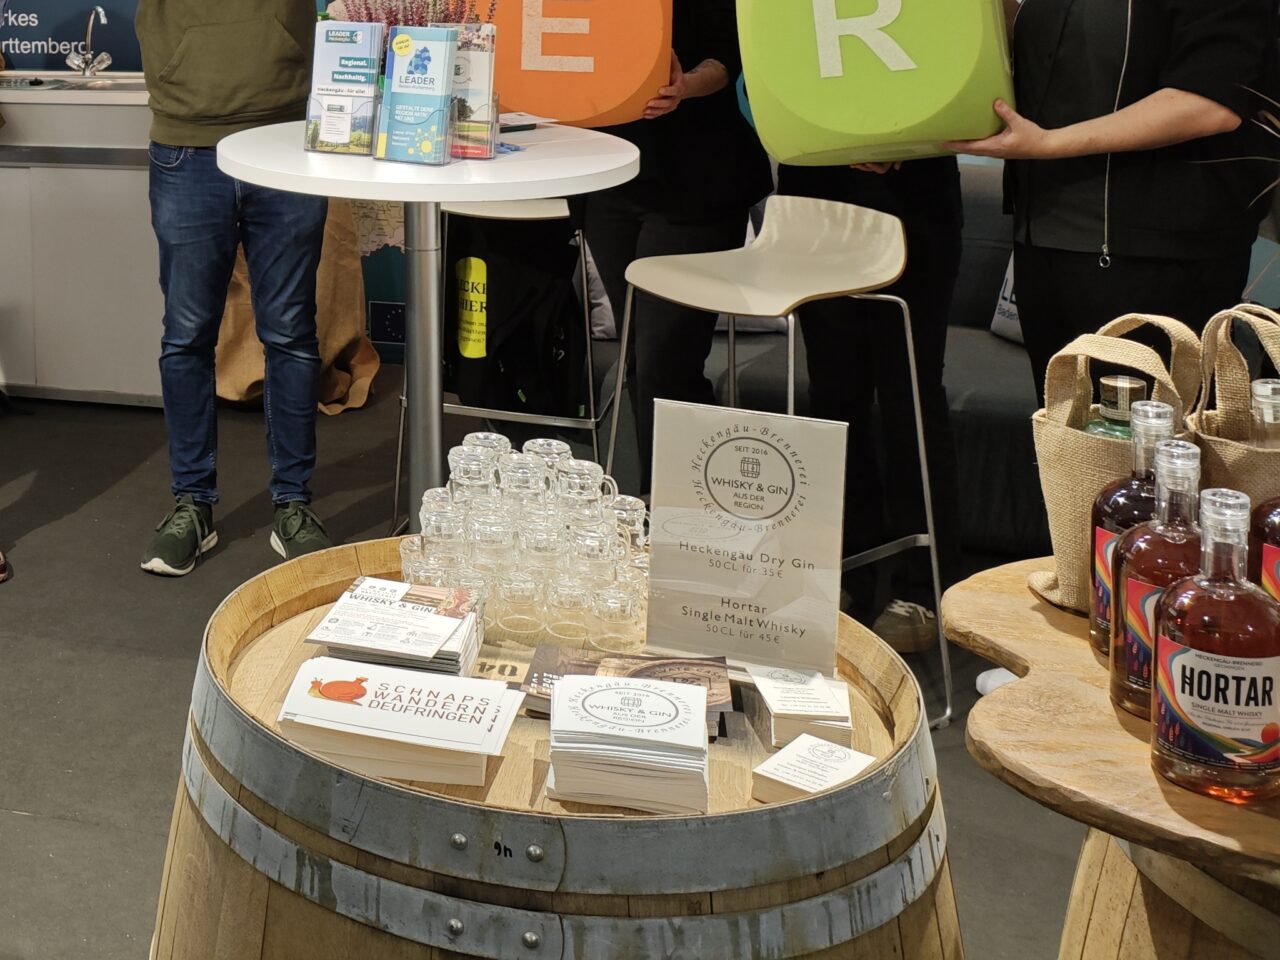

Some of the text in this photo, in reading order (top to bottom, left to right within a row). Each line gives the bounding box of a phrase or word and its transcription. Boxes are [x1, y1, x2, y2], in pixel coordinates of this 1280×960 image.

[1, 9, 38, 27] rkes
[333, 73, 367, 82] Nachhaltig.
[399, 75, 435, 86] LEADER
[734, 445, 769, 456] SEIT 2016
[711, 476, 789, 496] WHISKY & GIN
[733, 492, 765, 502] AUS DER
[734, 501, 764, 511] REGION
[679, 541, 816, 571] Heckengäu Dry Gin
[742, 565, 757, 575] für
[349, 593, 396, 607] WHISKY
[411, 605, 434, 614] GIN
[721, 597, 768, 615] Hortar
[682, 605, 807, 638] Single Malt Whisky
[739, 629, 754, 640] für
[378, 683, 490, 706] SCHNAPS
[1181, 664, 1274, 707] HORTAR
[368, 699, 482, 724] DEUFRINGEN
[374, 691, 486, 715] WANDERN
[588, 704, 637, 713] WHISKY
[1191, 701, 1216, 714] SINGLE
[1217, 708, 1236, 717] MALT
